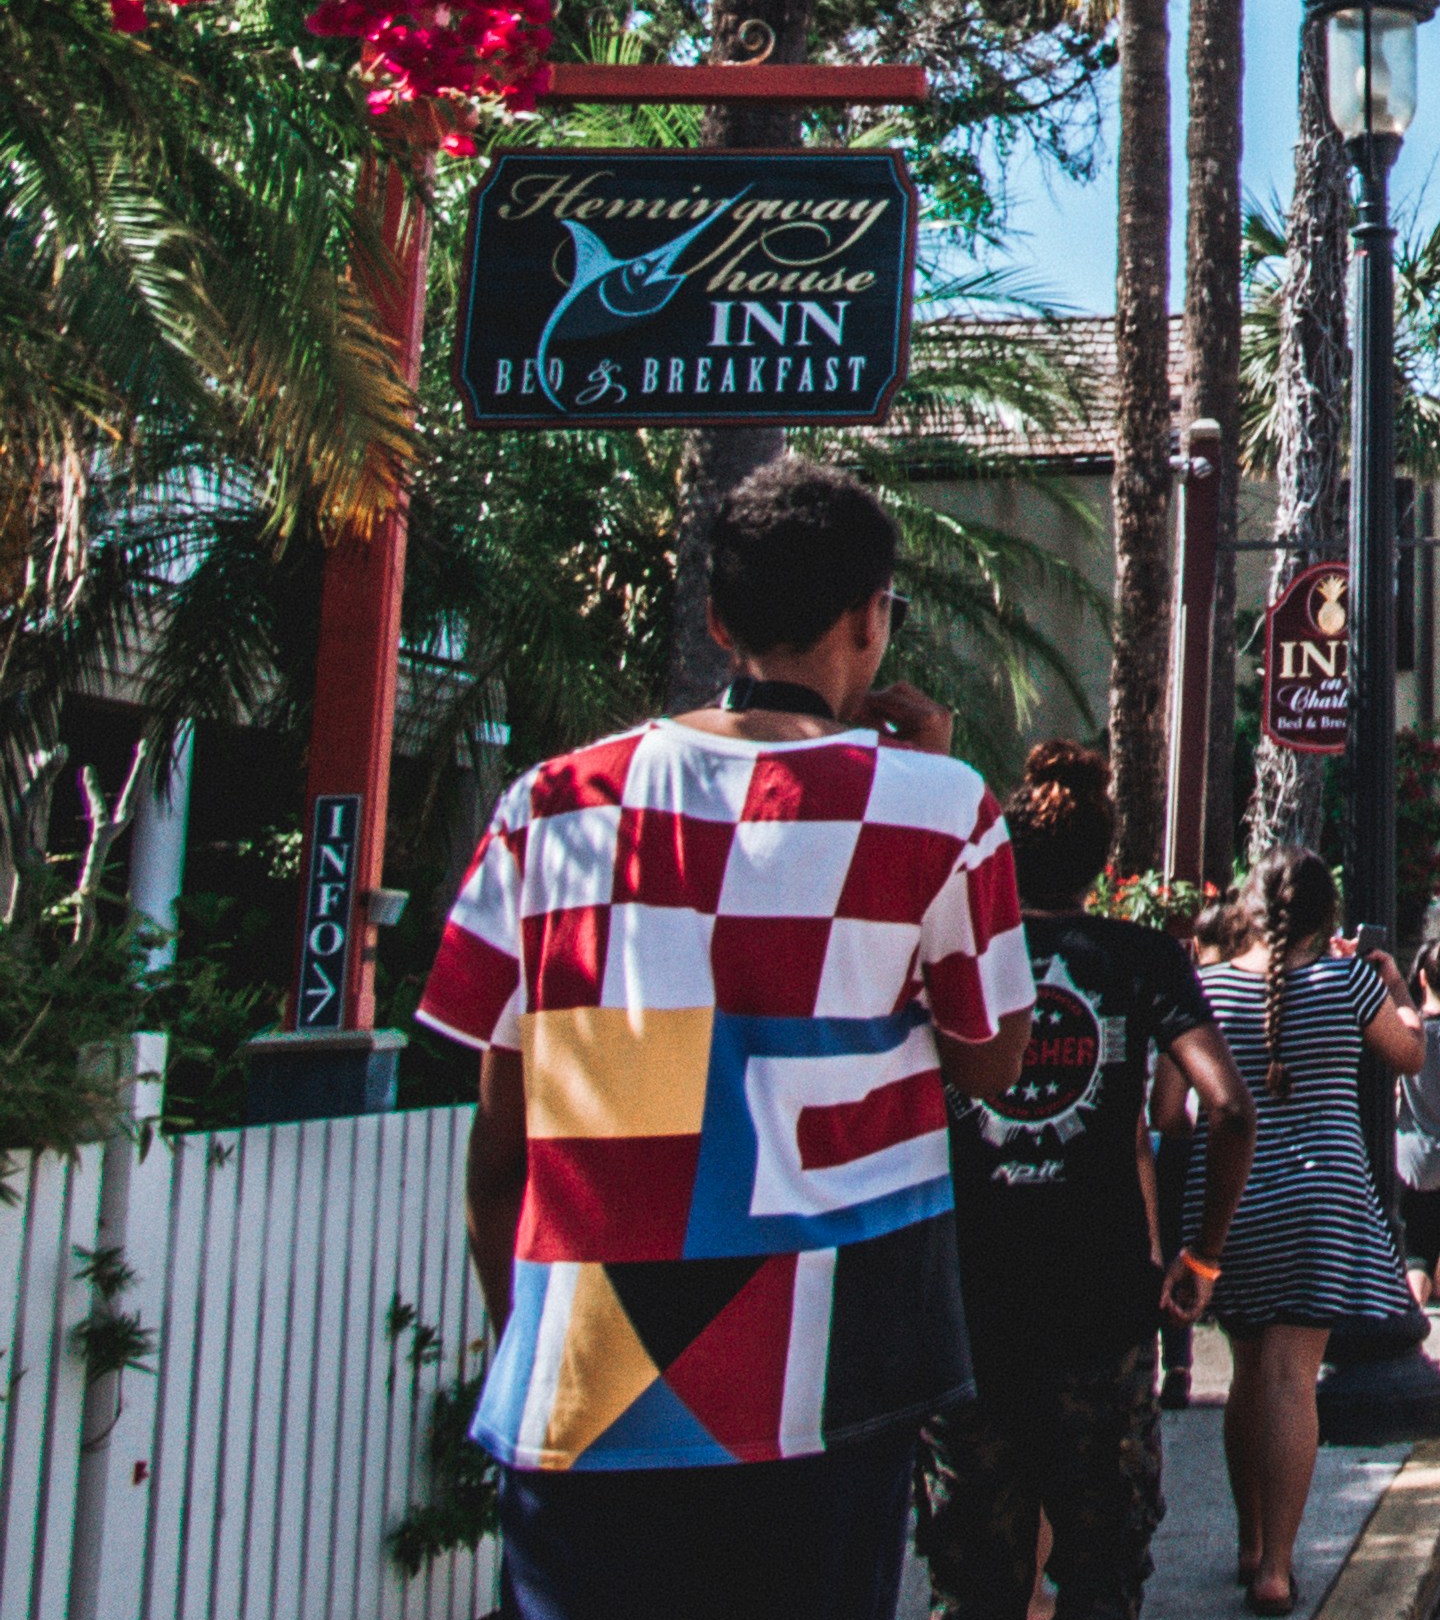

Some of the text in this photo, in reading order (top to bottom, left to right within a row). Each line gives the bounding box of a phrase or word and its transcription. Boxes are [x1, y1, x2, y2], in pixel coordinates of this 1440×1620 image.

[499, 170, 890, 266] Hemingway
[705, 239, 876, 293] house
[706, 300, 852, 348] INN
[494, 358, 564, 397] BED
[641, 356, 867, 395] BREAKFAST
[1279, 639, 1350, 679] IN
[1277, 684, 1349, 713] Charl
[1278, 716, 1302, 730] Bed
[308, 804, 349, 957] INFO
